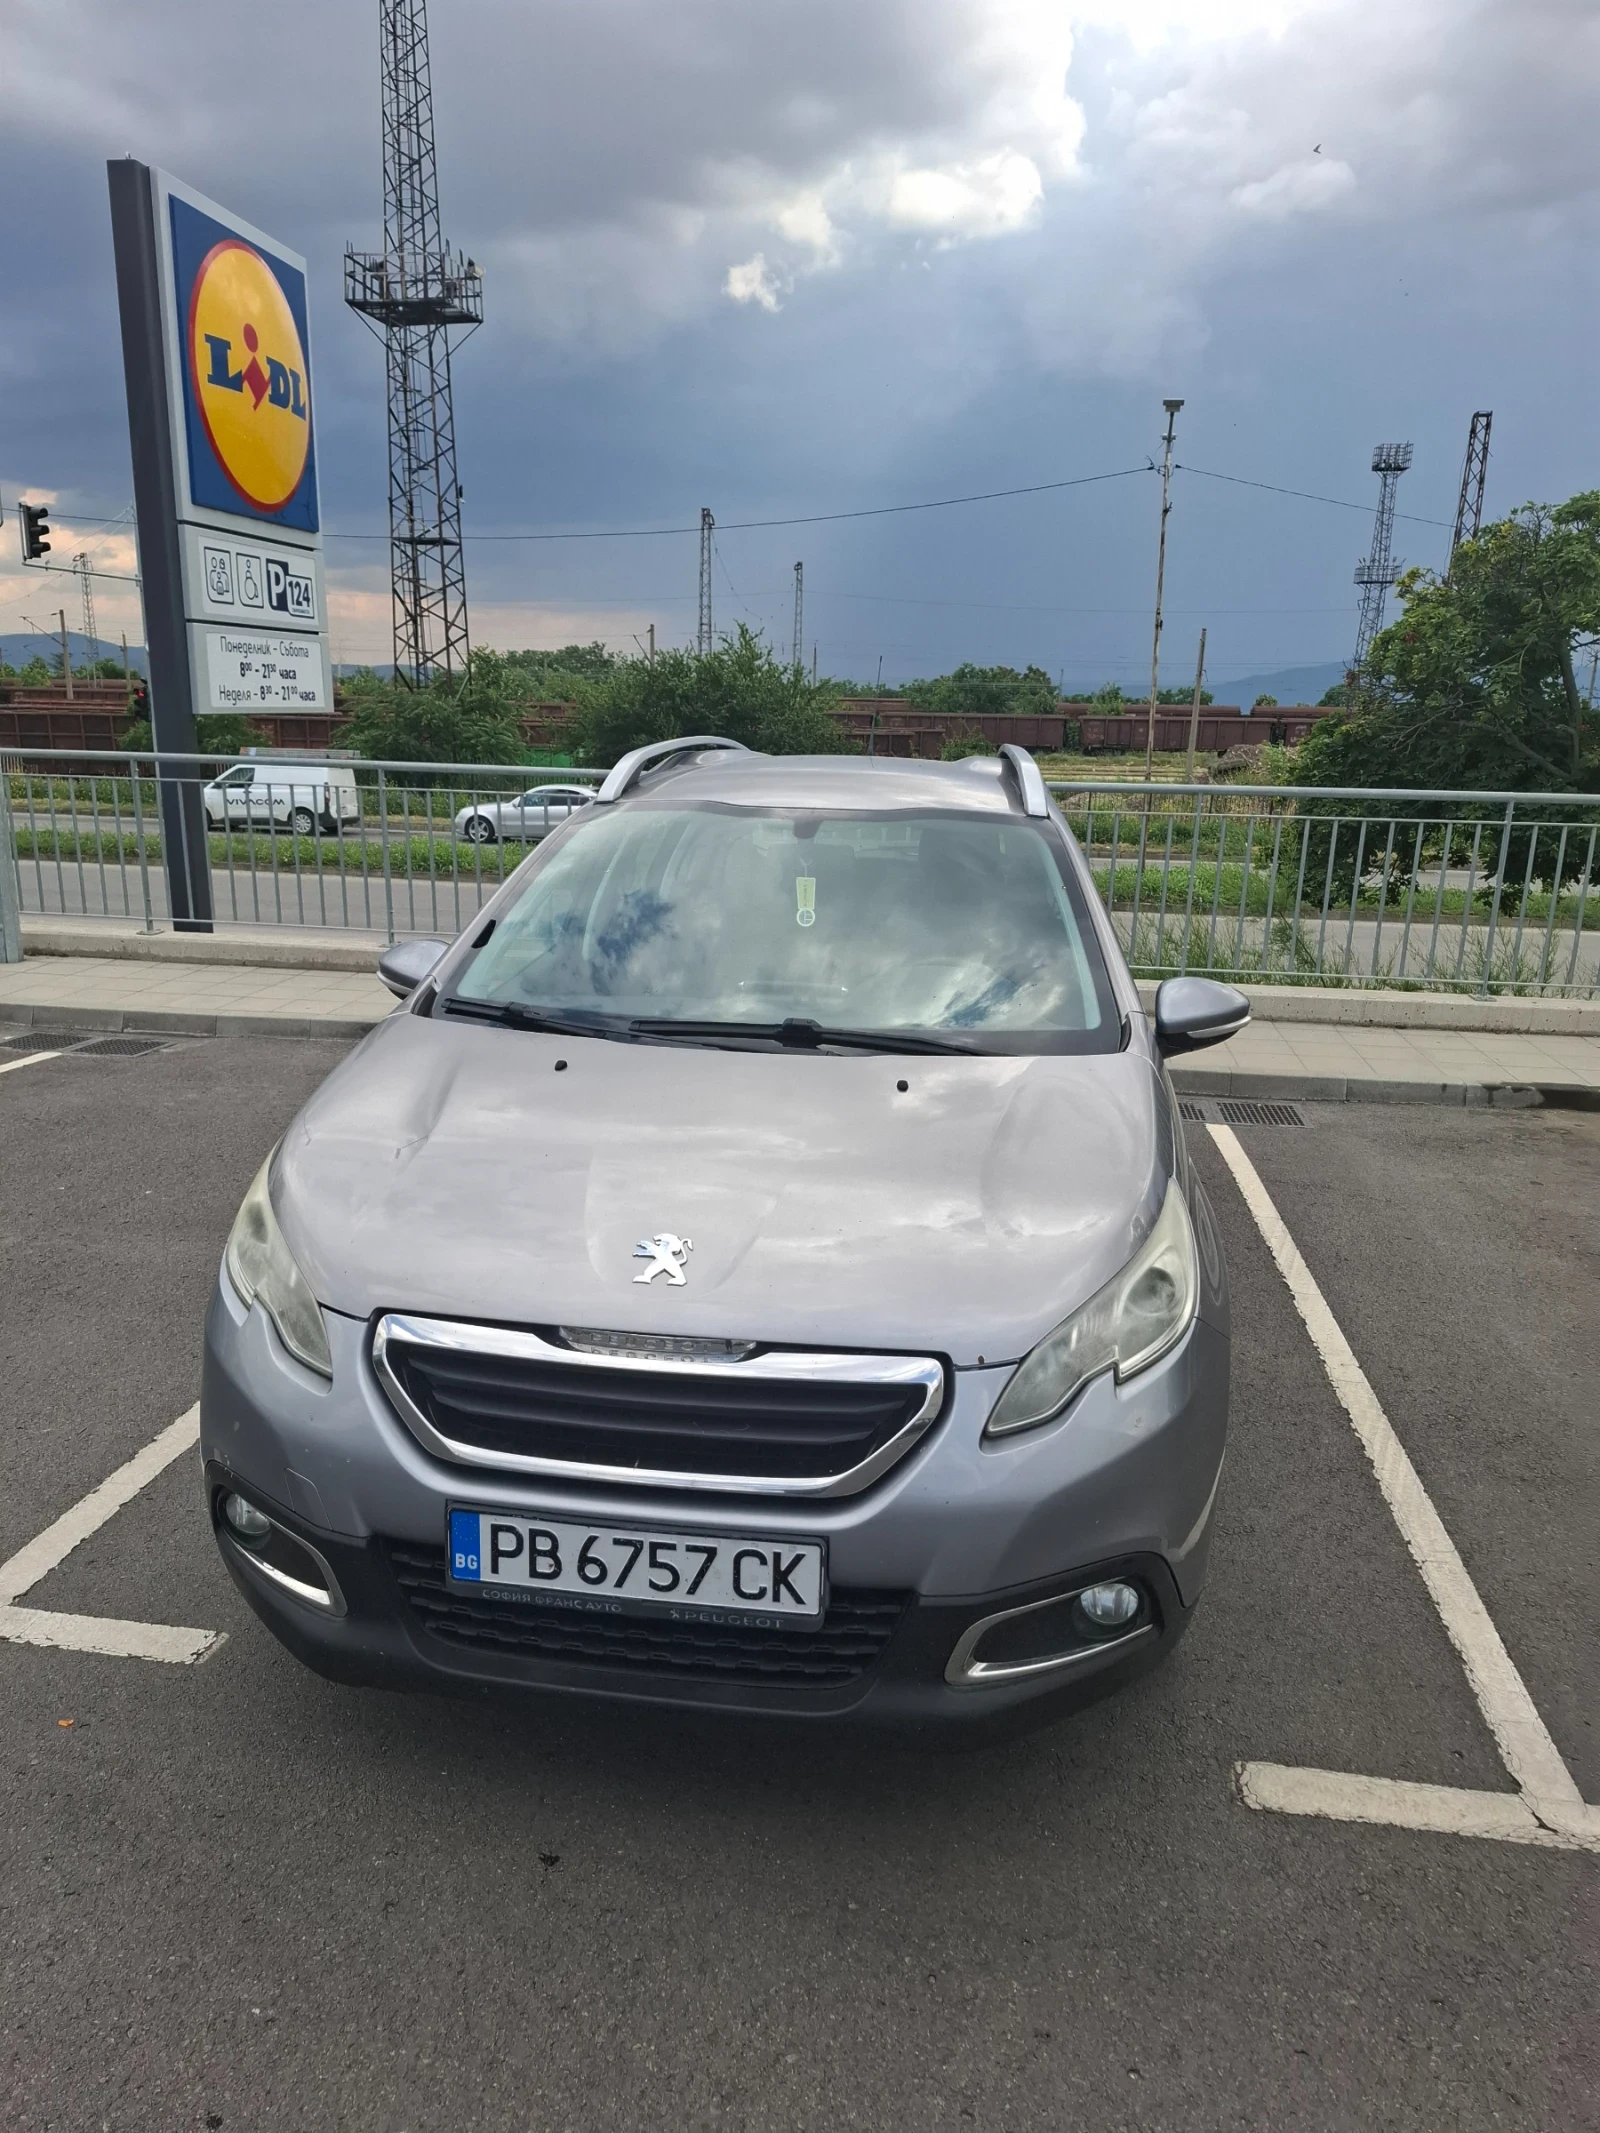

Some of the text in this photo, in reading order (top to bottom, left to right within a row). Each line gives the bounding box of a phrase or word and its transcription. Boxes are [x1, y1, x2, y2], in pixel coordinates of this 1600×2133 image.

[288, 580, 311, 608] 124
[220, 636, 272, 659] Понеделник
[279, 640, 309, 658] Събота
[279, 668, 297, 680] часа
[219, 685, 252, 706] Неделя
[299, 690, 316, 702] часа
[226, 798, 286, 806] VIVACOM
[455, 1552, 478, 1572] BG
[489, 1523, 807, 1605] PB 6757 CK
[482, 1589, 531, 1602] СОФИЯ
[535, 1596, 583, 1610] ФРАНС
[684, 1610, 784, 1628] PEUGEOT
